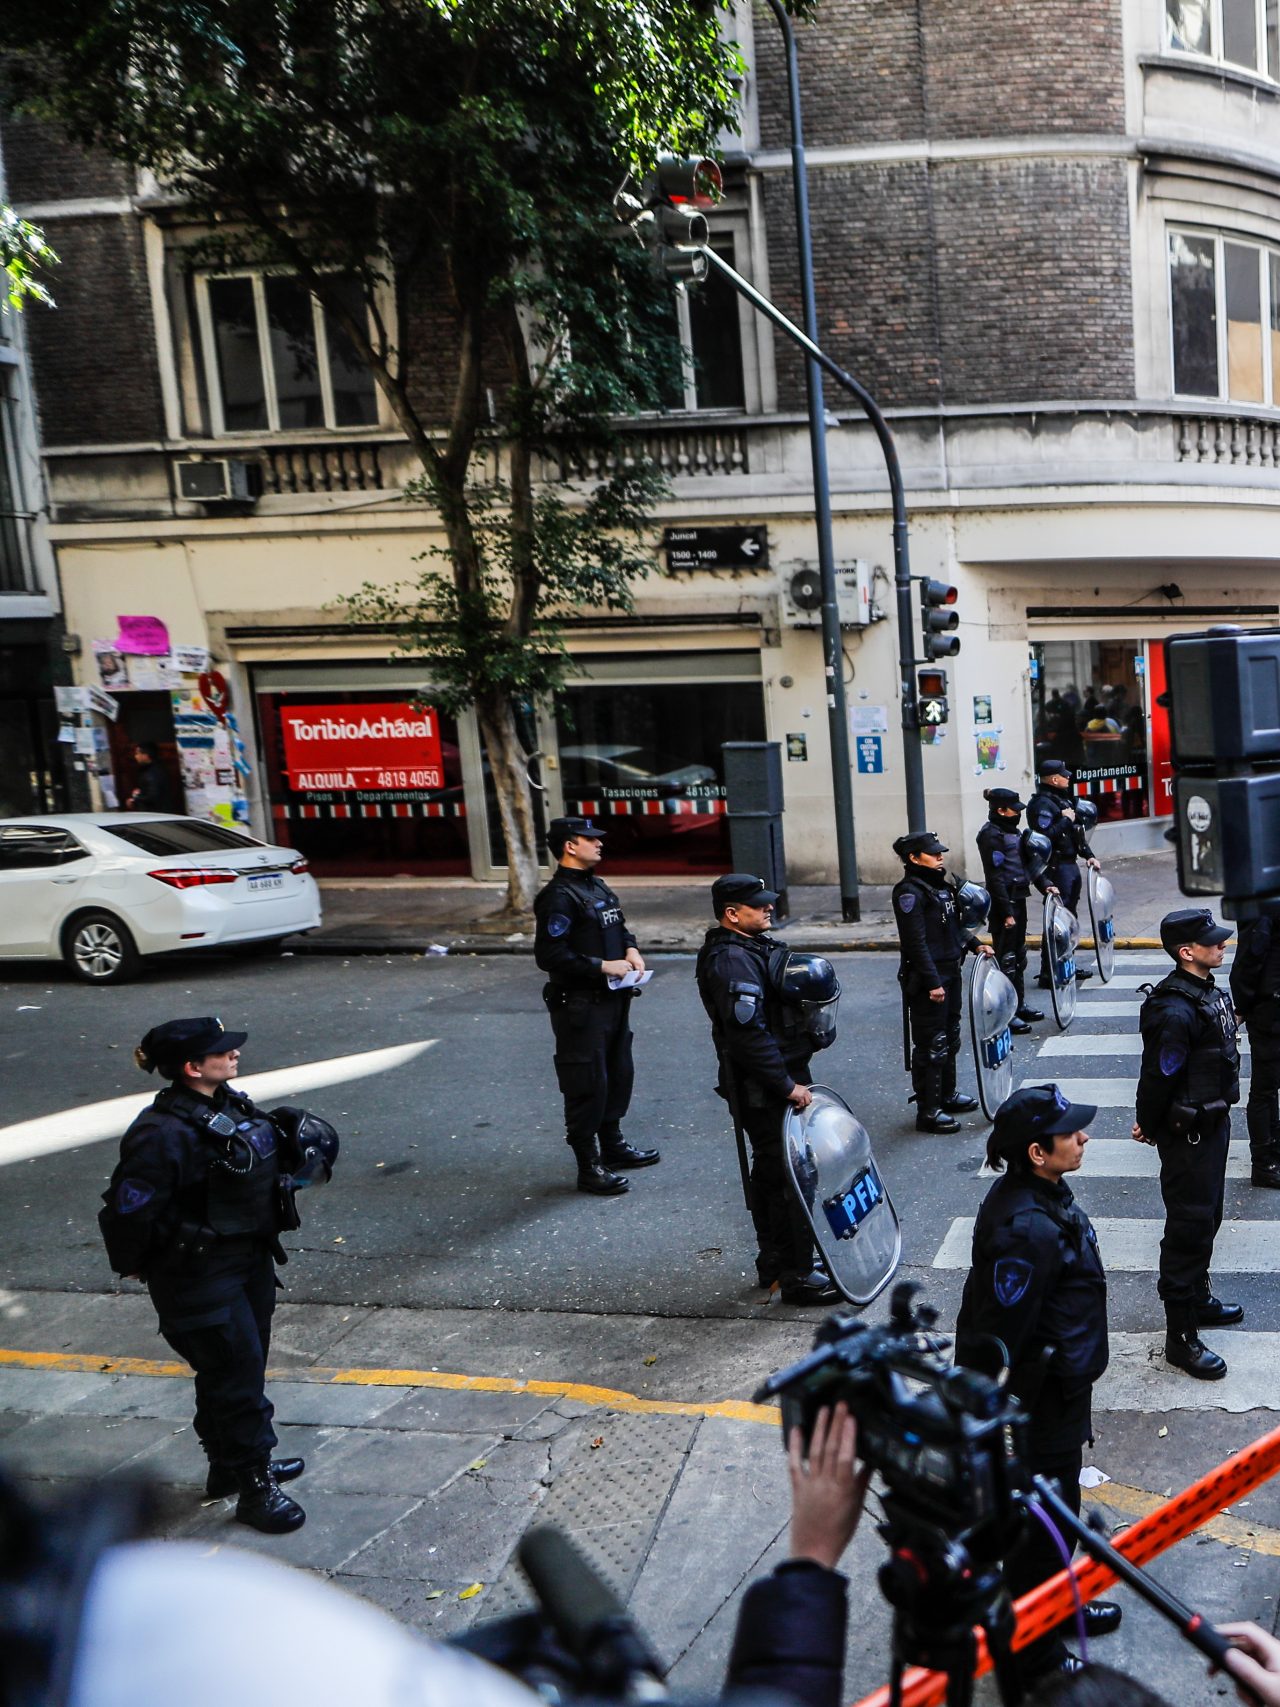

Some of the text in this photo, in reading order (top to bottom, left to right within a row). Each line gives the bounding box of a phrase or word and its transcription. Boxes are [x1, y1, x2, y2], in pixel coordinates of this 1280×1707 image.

[670, 531, 697, 540] Juncal
[672, 551, 691, 559] 1500
[697, 550, 717, 559] 1400
[288, 716, 432, 740] ToribioAchával
[1076, 765, 1137, 779] Departamentos
[298, 770, 439, 789] ALQUILA 4819 4050
[307, 790, 430, 800] Pisos Departamentos
[601, 786, 658, 797] Tasaciones
[842, 1174, 879, 1224] PFA
